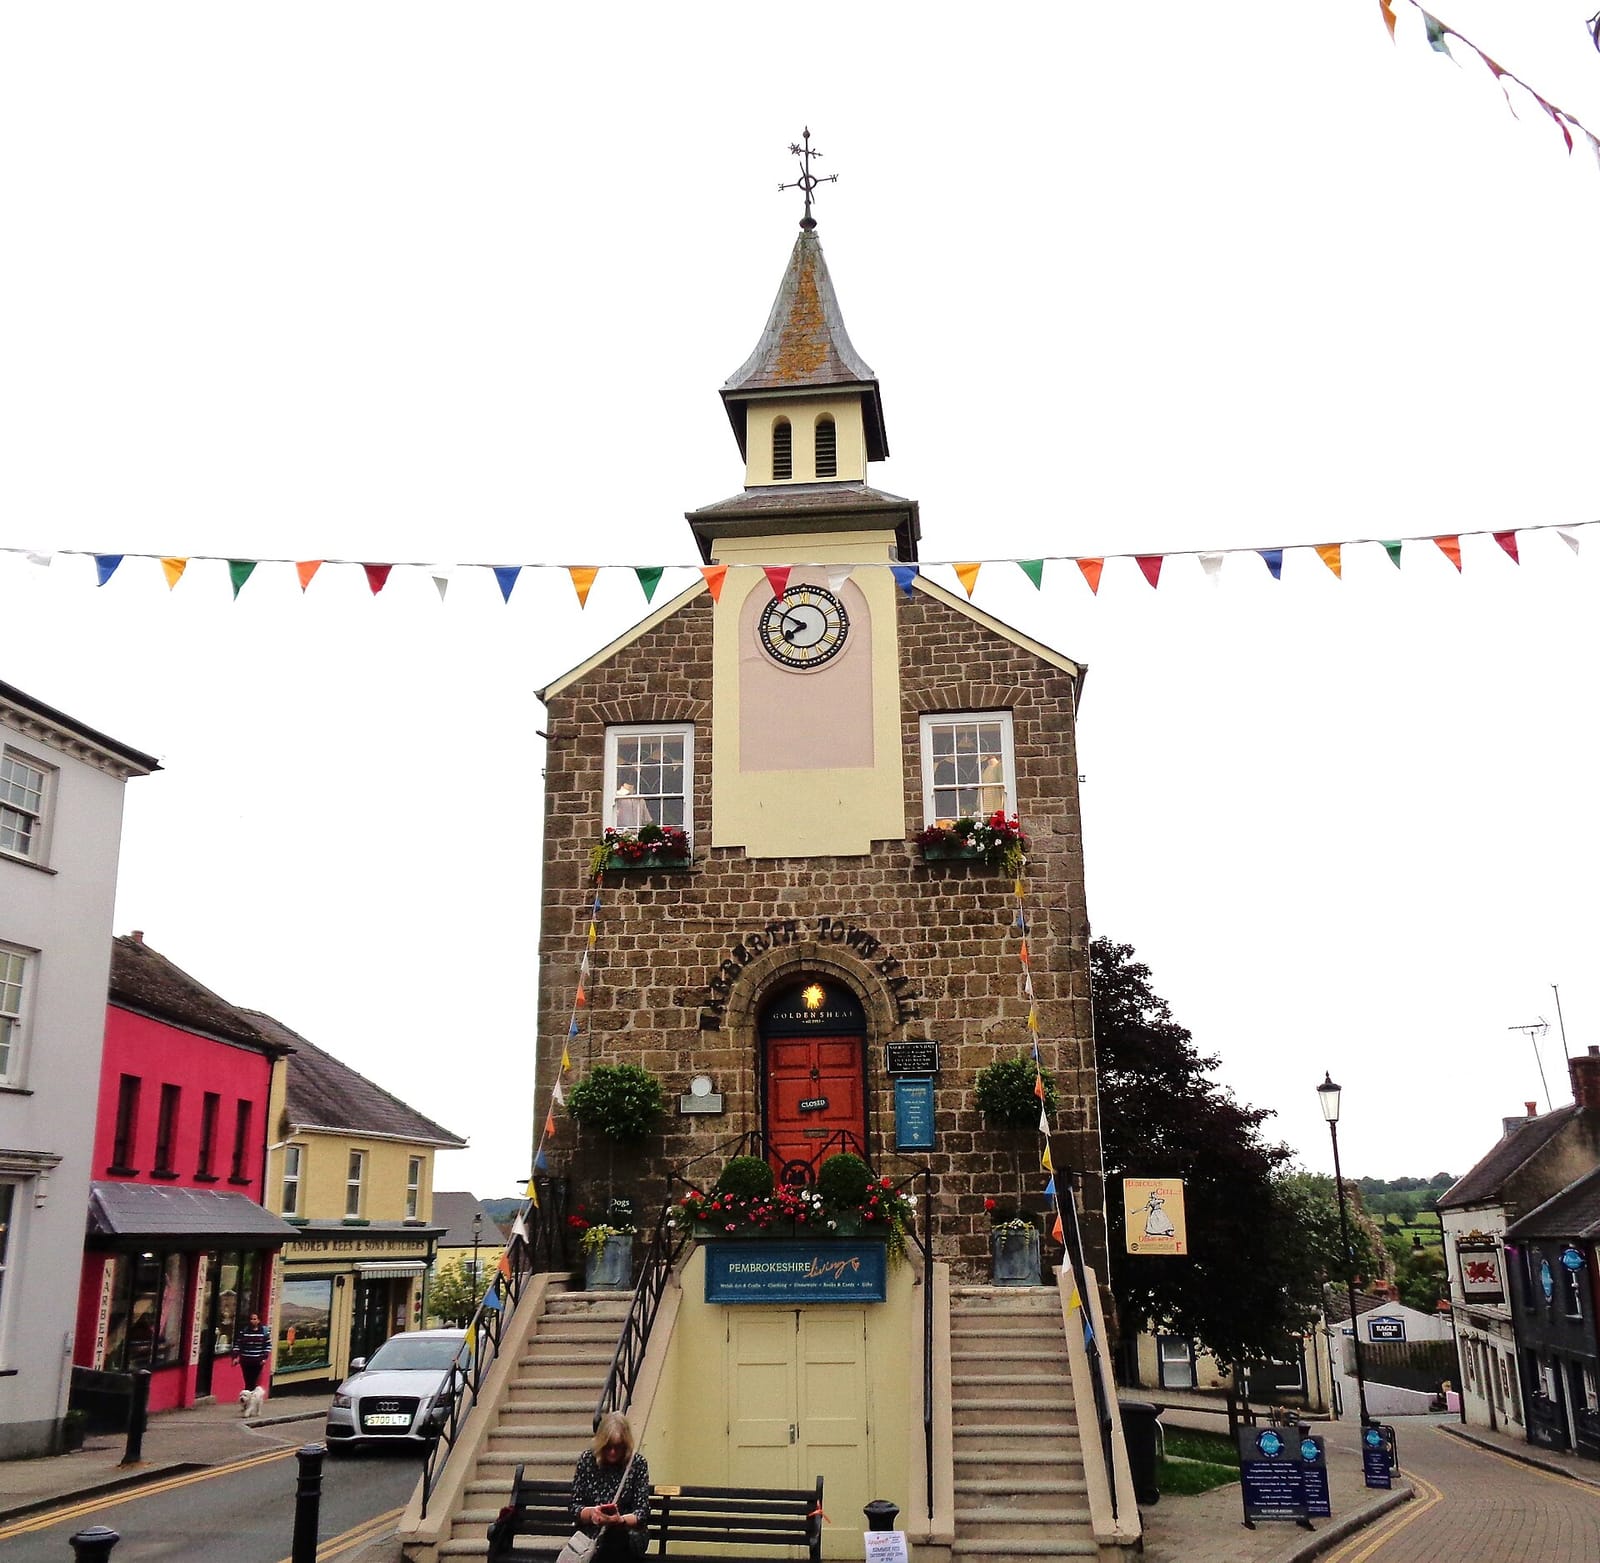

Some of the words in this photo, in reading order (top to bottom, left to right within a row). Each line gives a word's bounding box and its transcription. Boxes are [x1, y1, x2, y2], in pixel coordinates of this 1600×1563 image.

[700, 919, 798, 1031] NARBERTH
[818, 917, 881, 959] TOWN
[773, 1011, 816, 1019] GOLDEN
[801, 1099, 826, 1108] CLOSED
[610, 1198, 630, 1208] Dogs
[292, 1239, 328, 1252] ANDREW
[333, 1239, 353, 1251] REES
[365, 1239, 385, 1251] SONS
[386, 1239, 425, 1251] BUTCHERS
[729, 1262, 811, 1273] PEMBROKESHIRE
